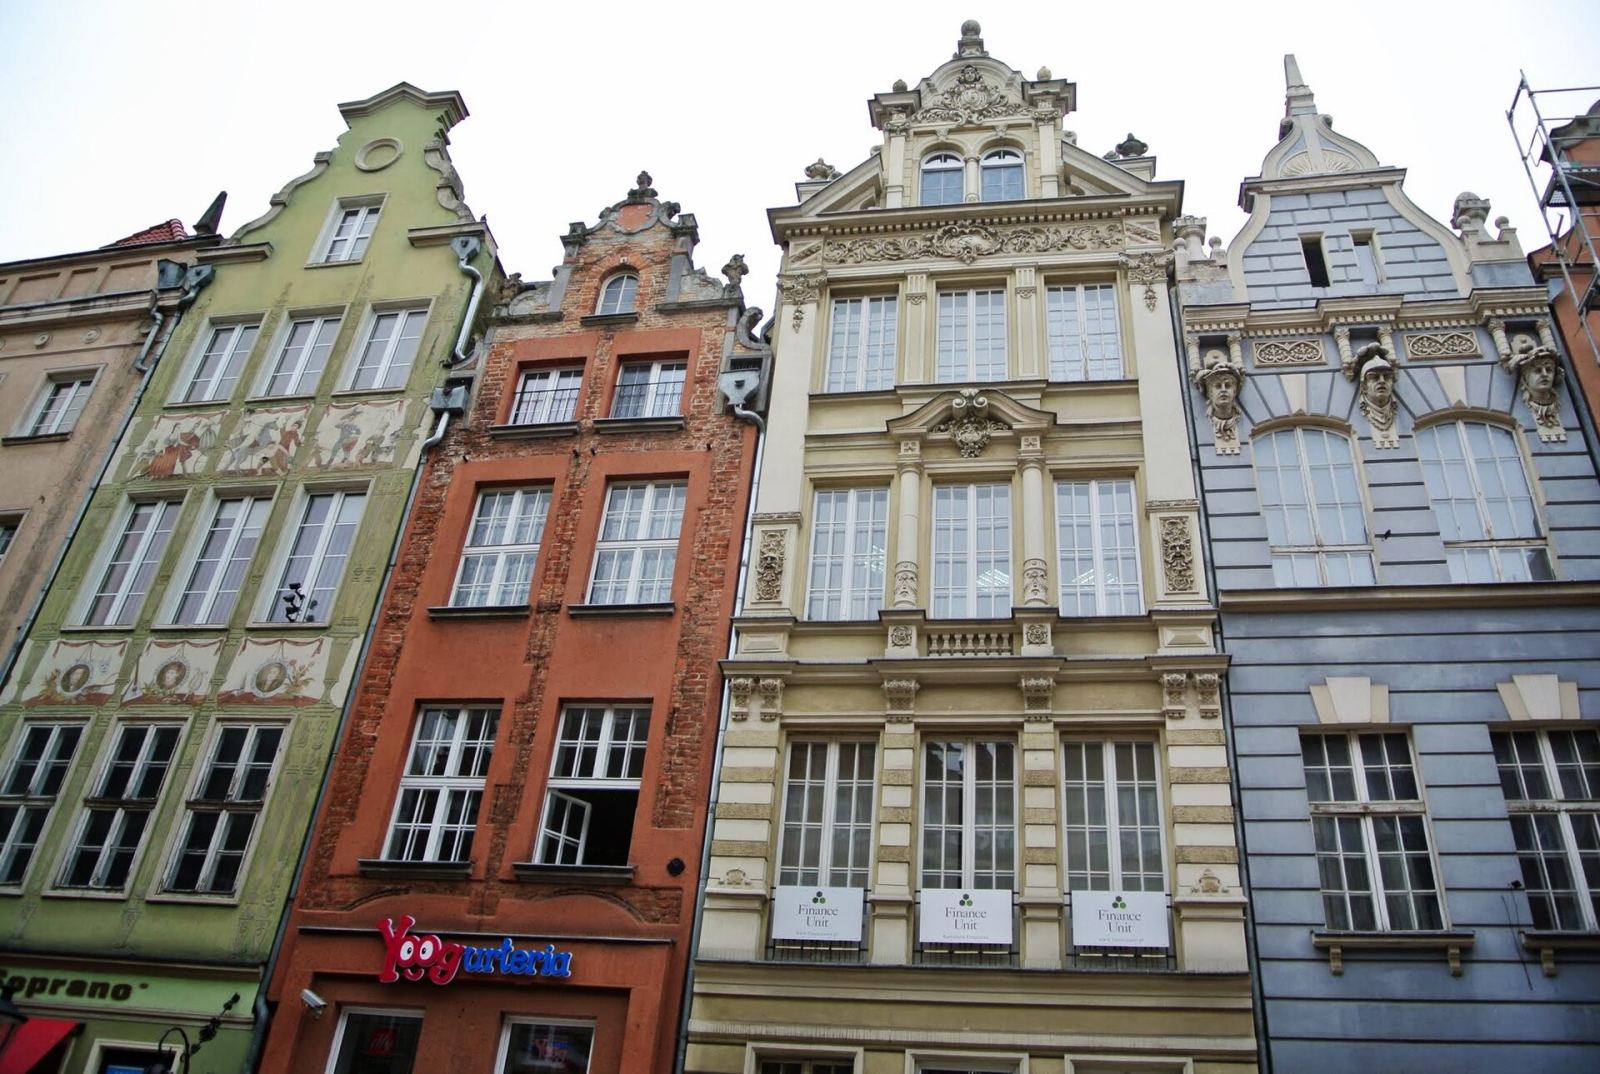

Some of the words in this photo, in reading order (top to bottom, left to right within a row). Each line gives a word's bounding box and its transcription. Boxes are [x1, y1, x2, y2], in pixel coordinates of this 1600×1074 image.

[798, 904, 839, 916] Finance
[945, 907, 987, 919] Finance
[1098, 909, 1141, 921] Finance
[806, 916, 829, 928] Unit
[954, 919, 977, 930] Unit
[1108, 921, 1132, 933] Unit
[377, 915, 571, 985] Yoogurteria
